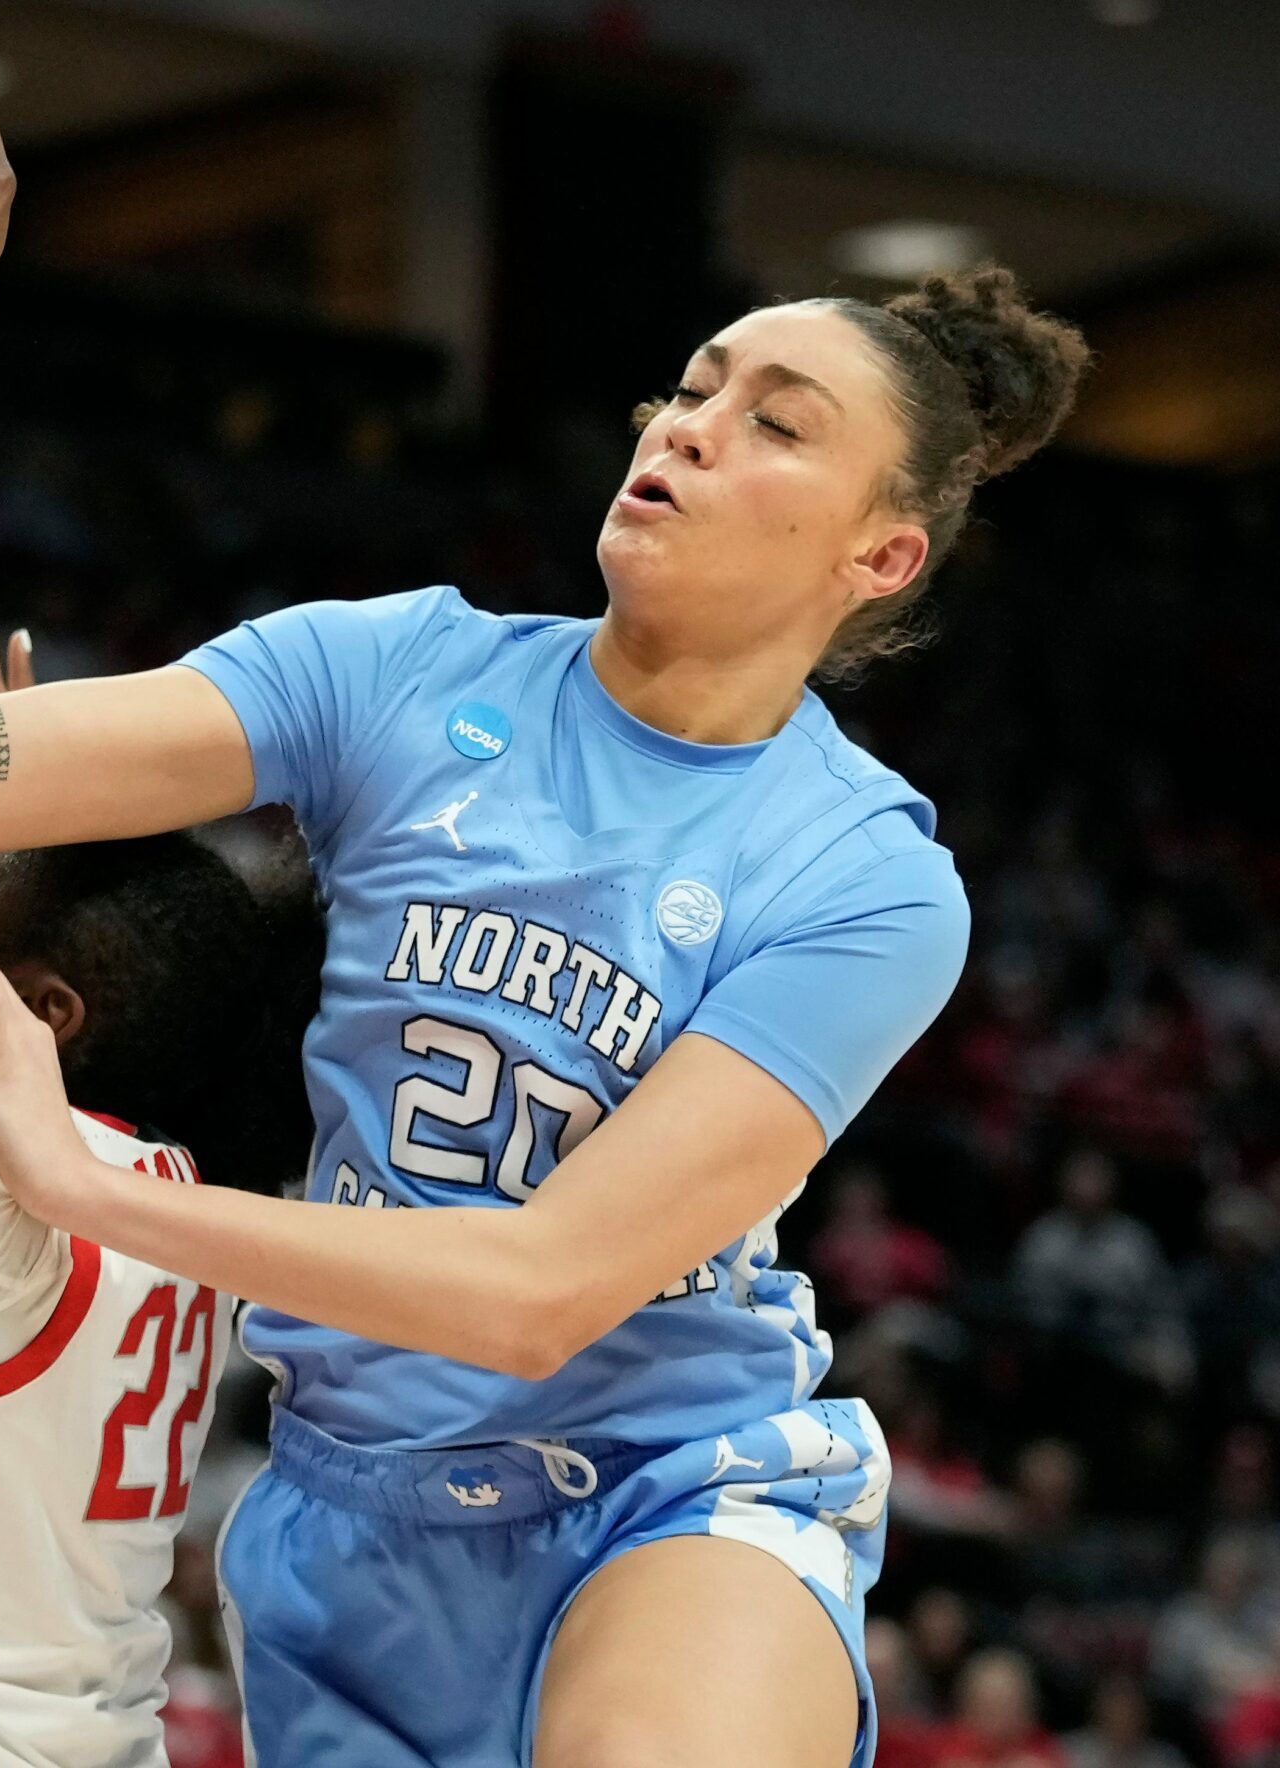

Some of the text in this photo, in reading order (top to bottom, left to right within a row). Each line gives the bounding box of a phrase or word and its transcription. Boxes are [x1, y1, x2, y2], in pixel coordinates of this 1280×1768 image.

[452, 719, 503, 754] NCAA
[384, 901, 663, 1072] NORTH
[388, 1013, 608, 1204] 20
[82, 1281, 218, 1523] 22
